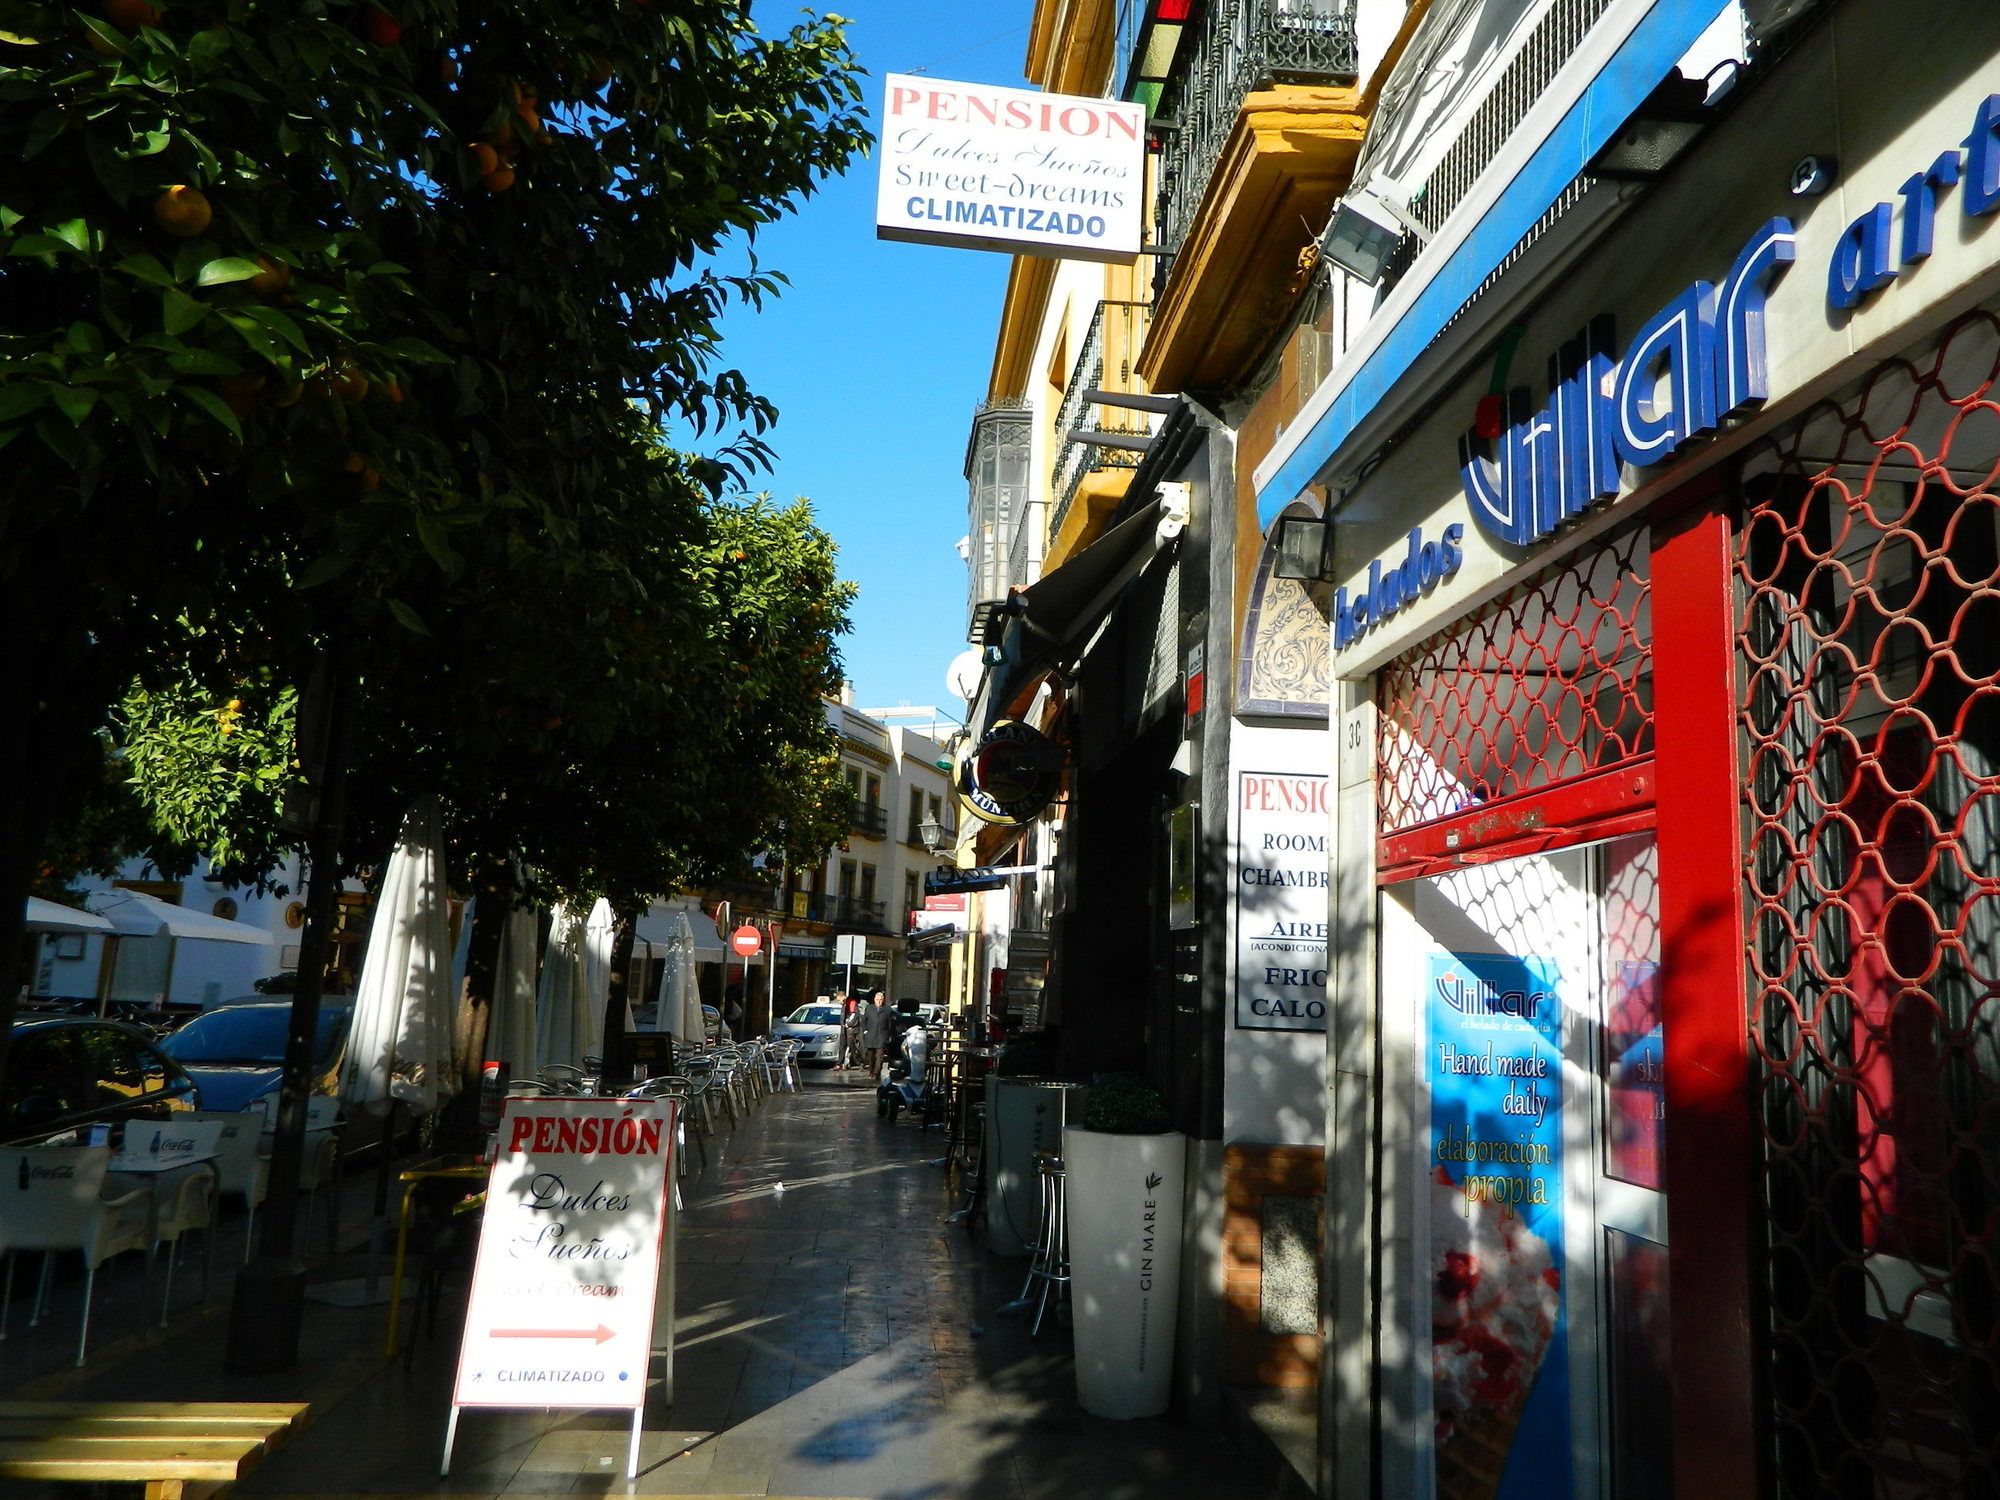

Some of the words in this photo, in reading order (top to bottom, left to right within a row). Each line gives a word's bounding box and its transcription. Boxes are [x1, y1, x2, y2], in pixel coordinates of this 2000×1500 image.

[891, 86, 1138, 142] PENSION
[895, 128, 999, 165] Dulces
[1015, 141, 1129, 179] Sueños
[896, 163, 1125, 209] Sweet-dreams
[906, 196, 1107, 238] CLIMATIZADO
[1458, 215, 1796, 546] Villar
[1263, 833, 1329, 852] ROOM
[1270, 921, 1328, 937] AIRE
[1435, 977, 1545, 1019] Villar
[1439, 1041, 1493, 1075] Hand
[1496, 1043, 1547, 1078] made
[1503, 1081, 1547, 1127] daily
[508, 1108, 664, 1155] PENSIÓN
[1437, 1124, 1551, 1165] elaboración
[519, 1173, 632, 1212] Dulces
[1464, 1167, 1550, 1218] propia
[509, 1222, 633, 1260] Sueños
[1142, 1199, 1156, 1253] MARE
[1141, 1258, 1152, 1291] GIN
[497, 1370, 605, 1383] CLIMATIZADO
